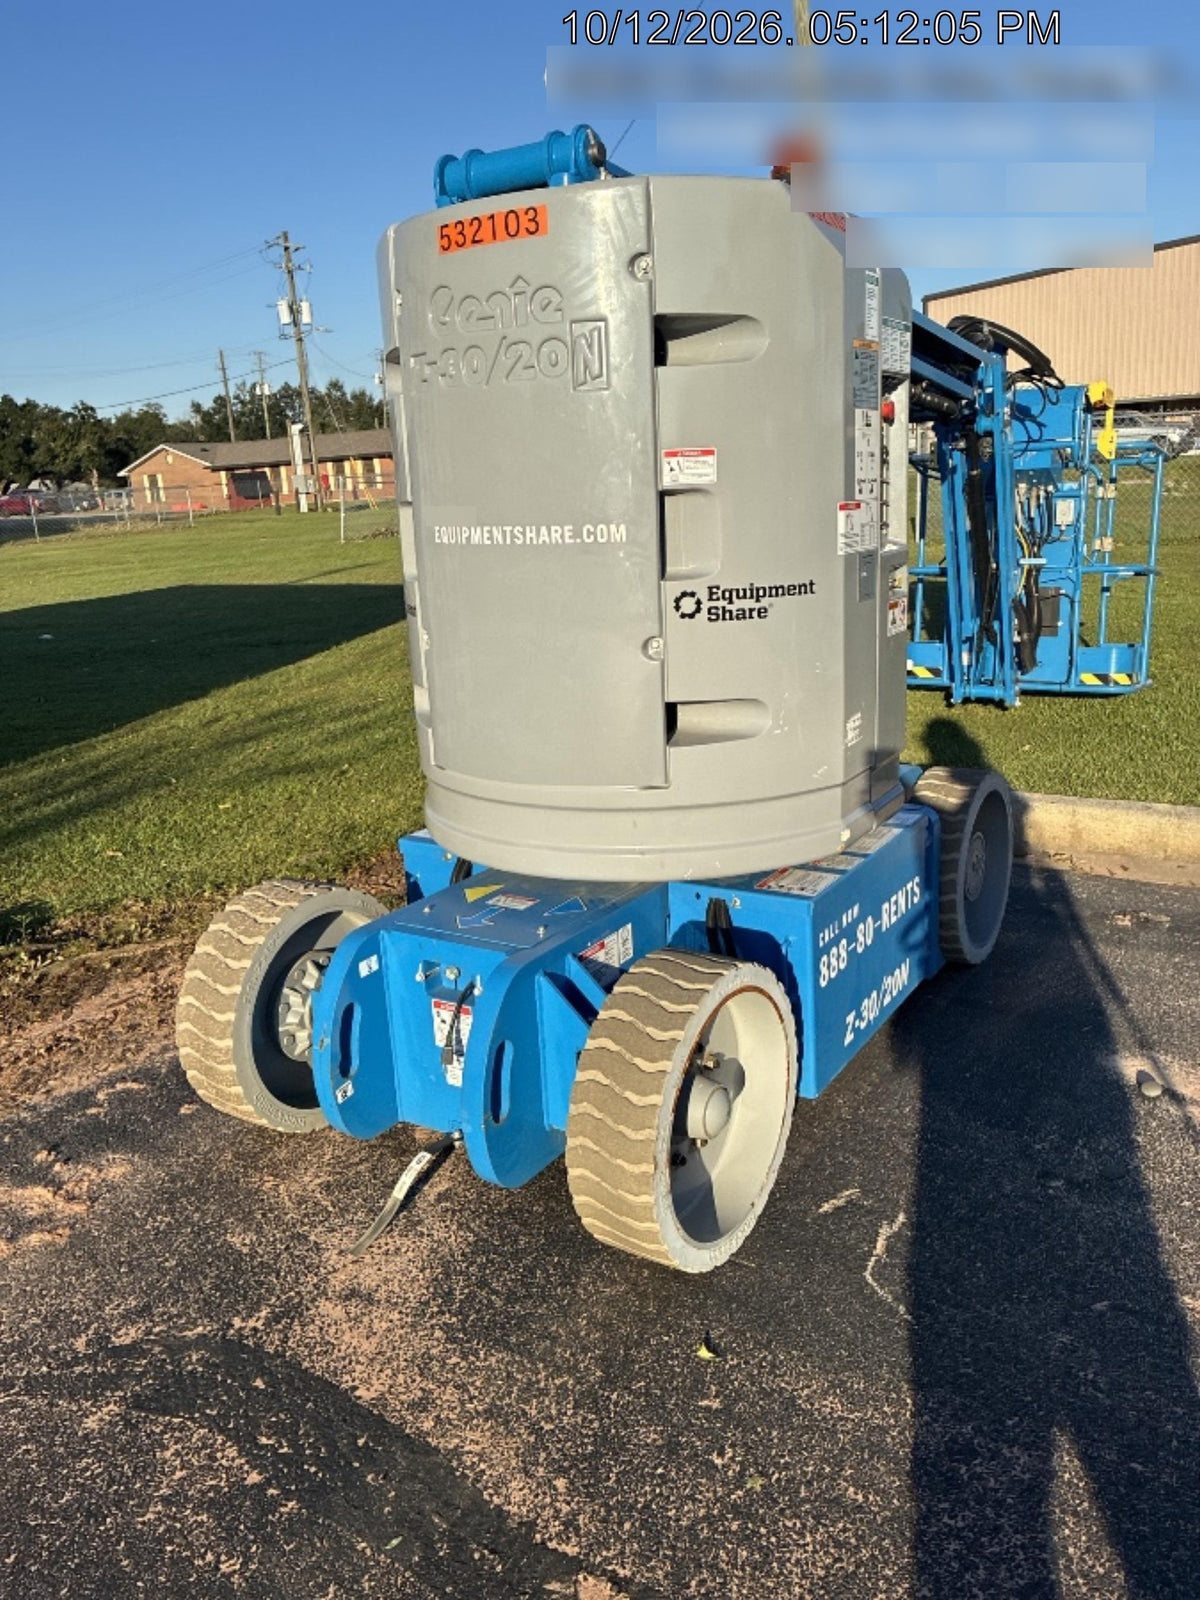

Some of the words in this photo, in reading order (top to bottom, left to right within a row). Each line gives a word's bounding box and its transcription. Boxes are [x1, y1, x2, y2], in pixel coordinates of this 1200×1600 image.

[439, 206, 541, 252] 532103
[429, 275, 564, 336] Genie
[434, 523, 627, 545] EQUIPMENTSHARE.COM
[707, 579, 816, 605] Equipment
[707, 605, 769, 623] Share
[819, 920, 839, 948] CALL
[842, 902, 860, 929] NOW
[819, 875, 921, 988] 888-80-RENTS
[844, 957, 910, 1048] Z-30/20N
